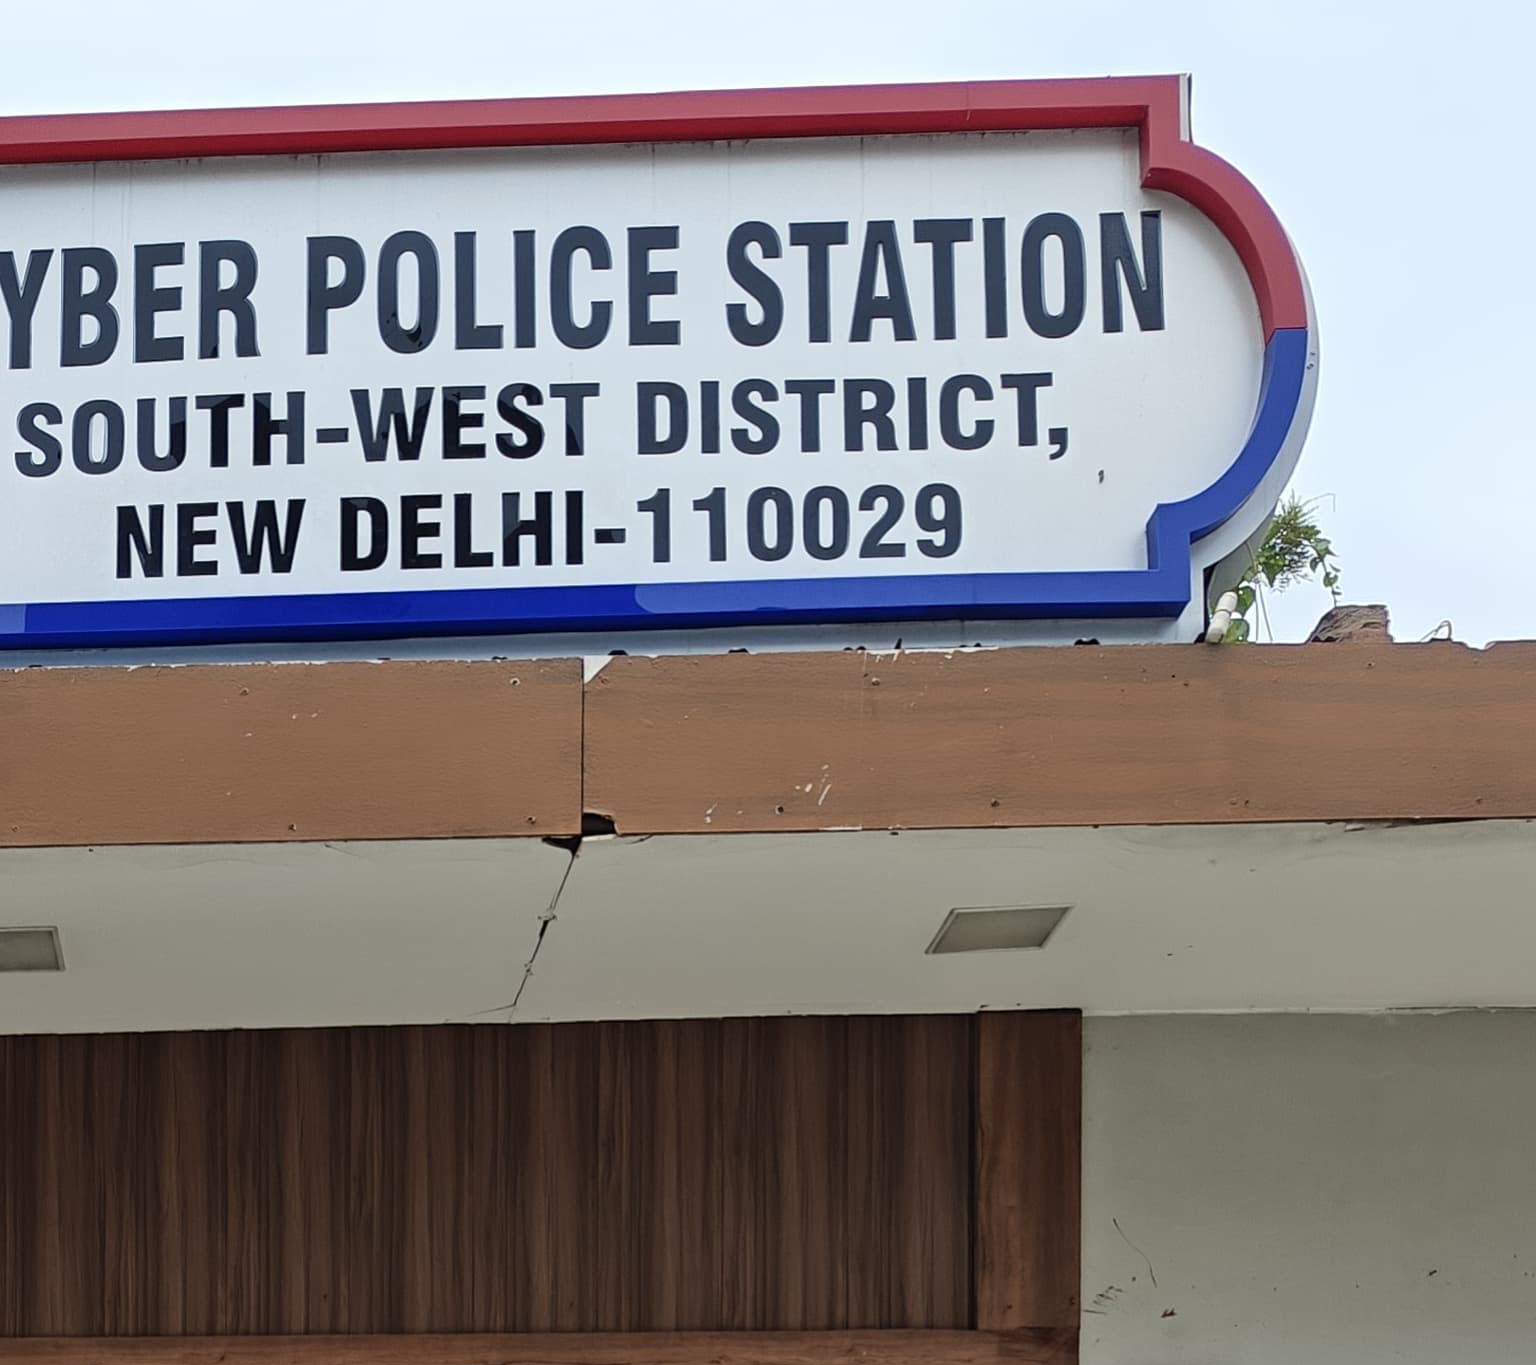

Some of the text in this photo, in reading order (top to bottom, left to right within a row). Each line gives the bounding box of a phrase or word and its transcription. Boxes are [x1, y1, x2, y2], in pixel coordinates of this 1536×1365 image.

[306, 226, 681, 355] POLICE
[726, 210, 1165, 347] STATION
[14, 372, 1068, 478] SOUTH-WEST DISTRICT,
[116, 483, 962, 579] NEW DELHI-110029
